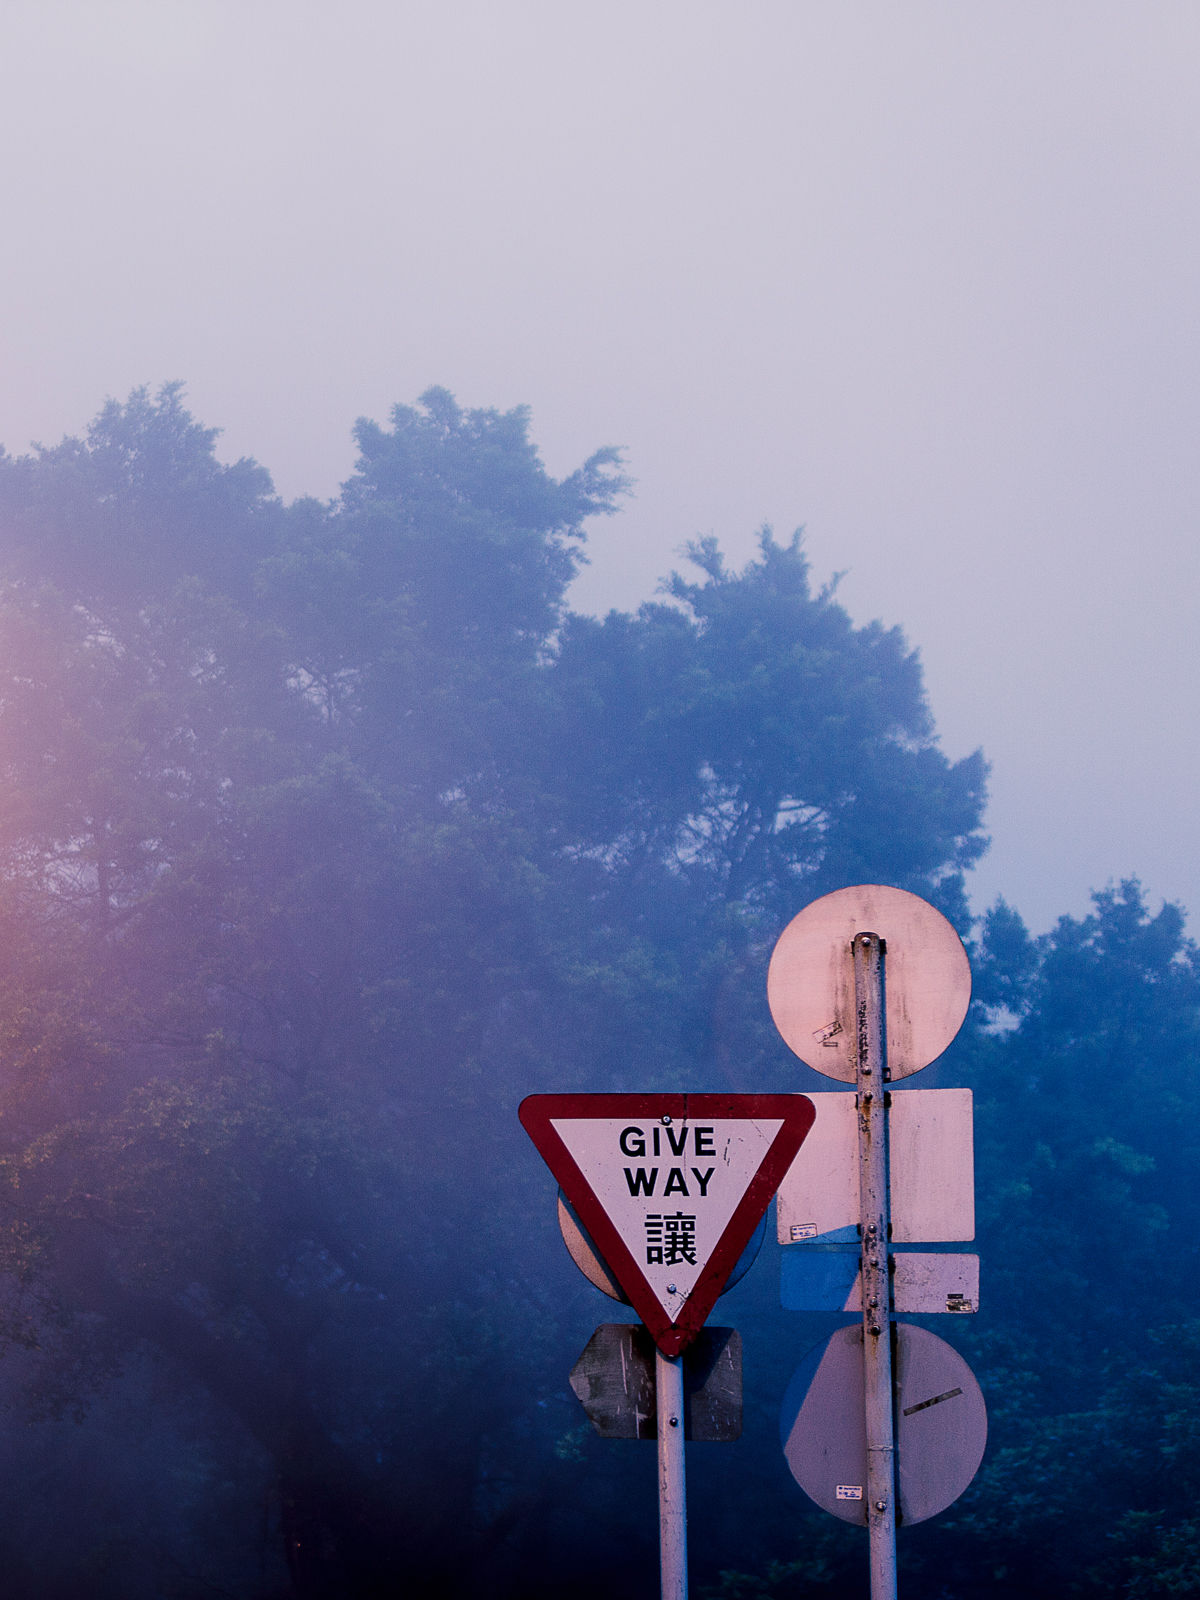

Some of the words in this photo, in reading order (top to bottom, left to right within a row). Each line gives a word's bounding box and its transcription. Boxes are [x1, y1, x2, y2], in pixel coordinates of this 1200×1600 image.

[619, 1126, 717, 1157] GIVE
[623, 1167, 716, 1197] WAY
[644, 1211, 698, 1266] 讓
